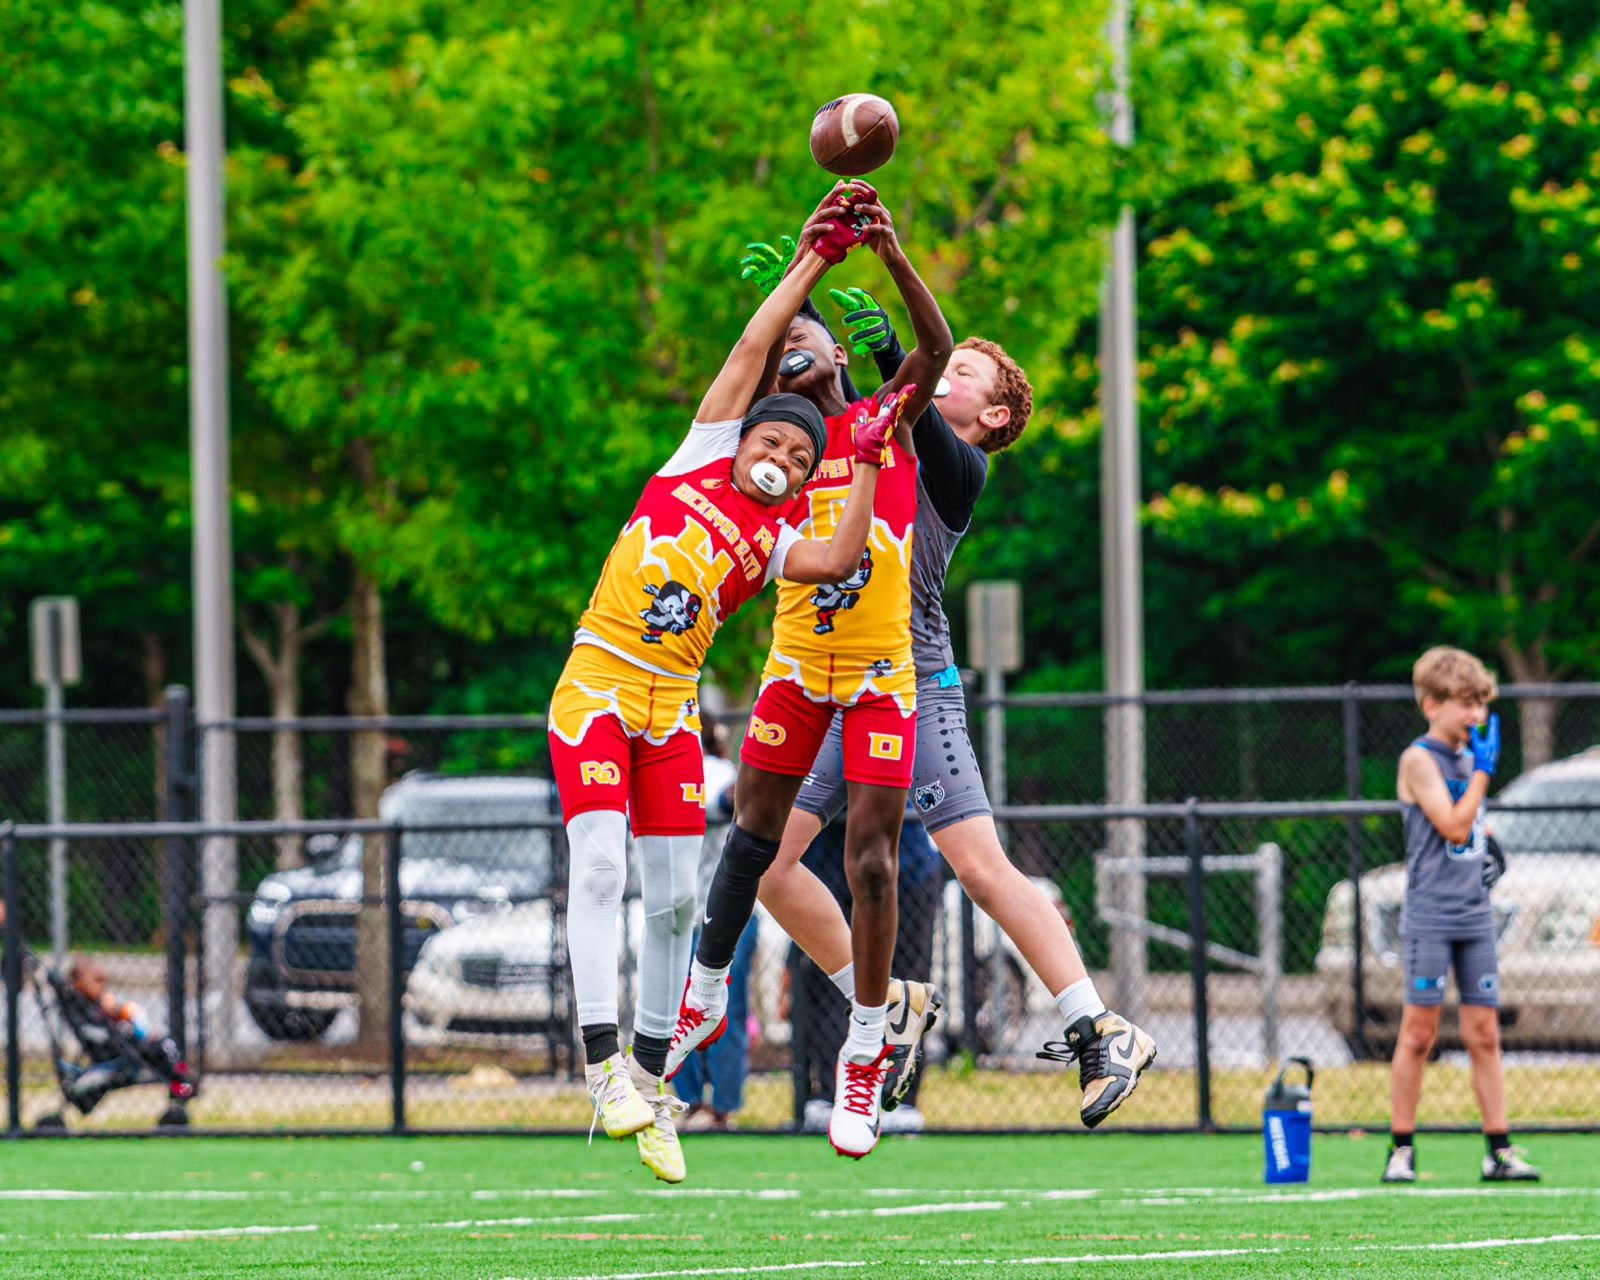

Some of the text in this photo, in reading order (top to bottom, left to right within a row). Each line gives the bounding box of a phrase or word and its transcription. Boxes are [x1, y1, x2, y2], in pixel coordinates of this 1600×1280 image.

[670, 482, 762, 581] BUCKEYES ELITE
[680, 783, 706, 809] 4
